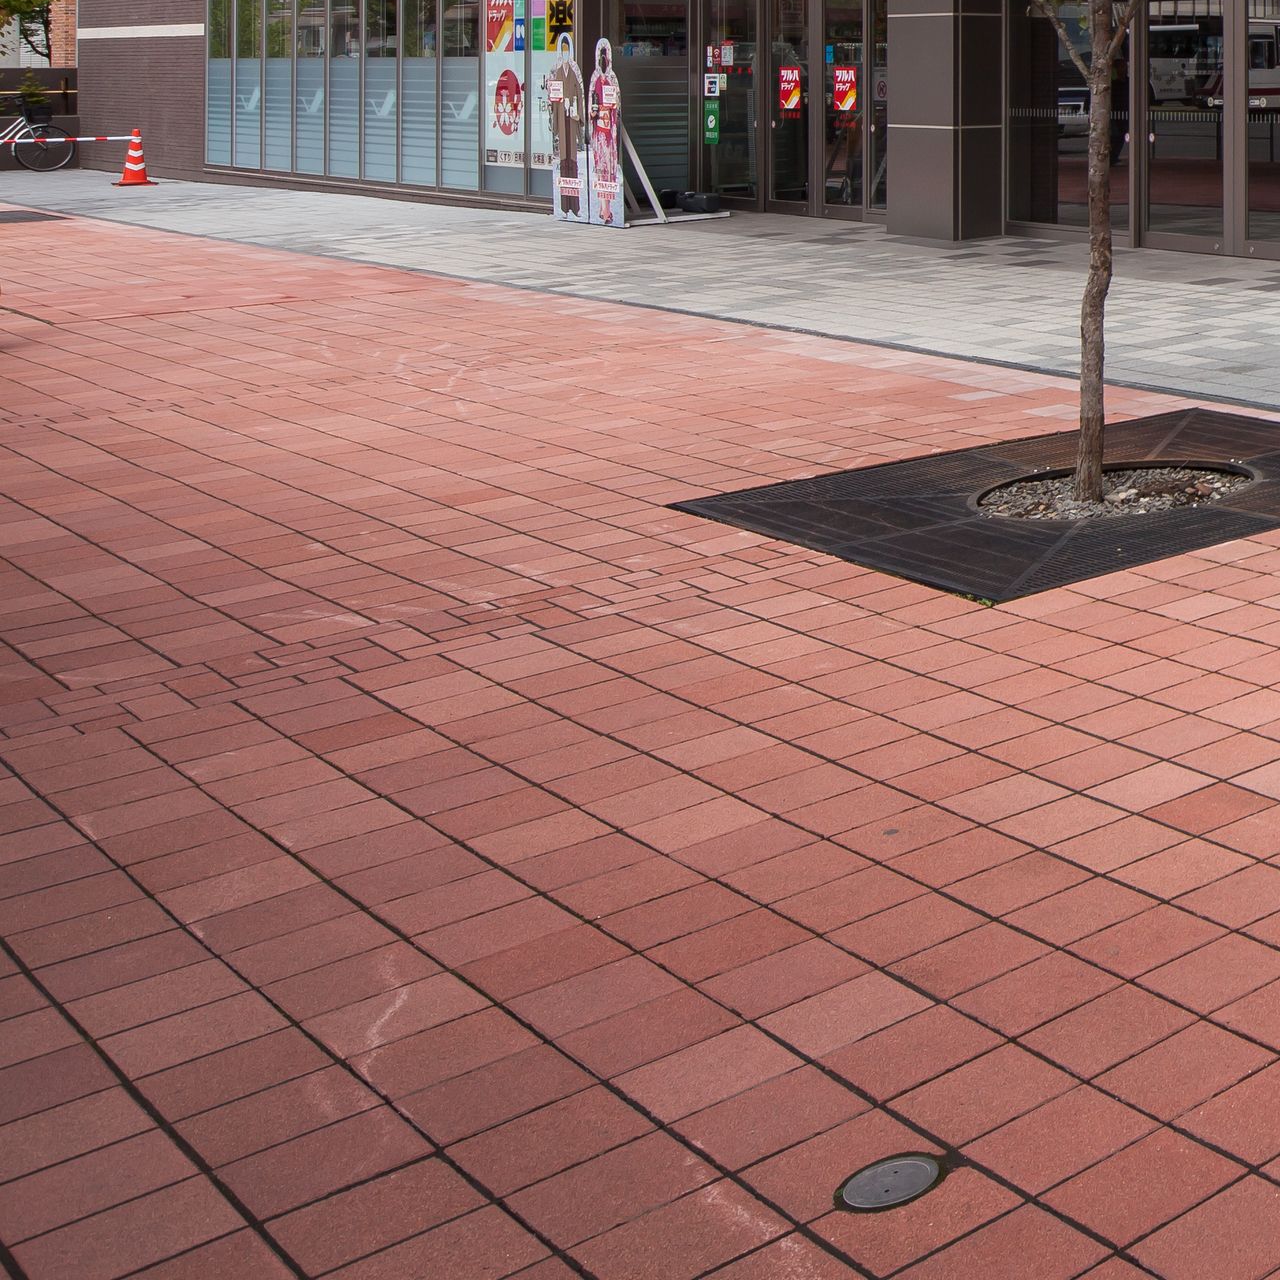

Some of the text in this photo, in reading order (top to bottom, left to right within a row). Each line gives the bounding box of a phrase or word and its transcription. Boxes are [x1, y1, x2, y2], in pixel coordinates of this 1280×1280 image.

[488, 9, 507, 23] ドラッグ
[781, 69, 799, 81] ツルハ
[836, 70, 855, 82] ツルハ
[781, 82, 795, 91] ドラッグ
[836, 83, 851, 91] ドラッグ
